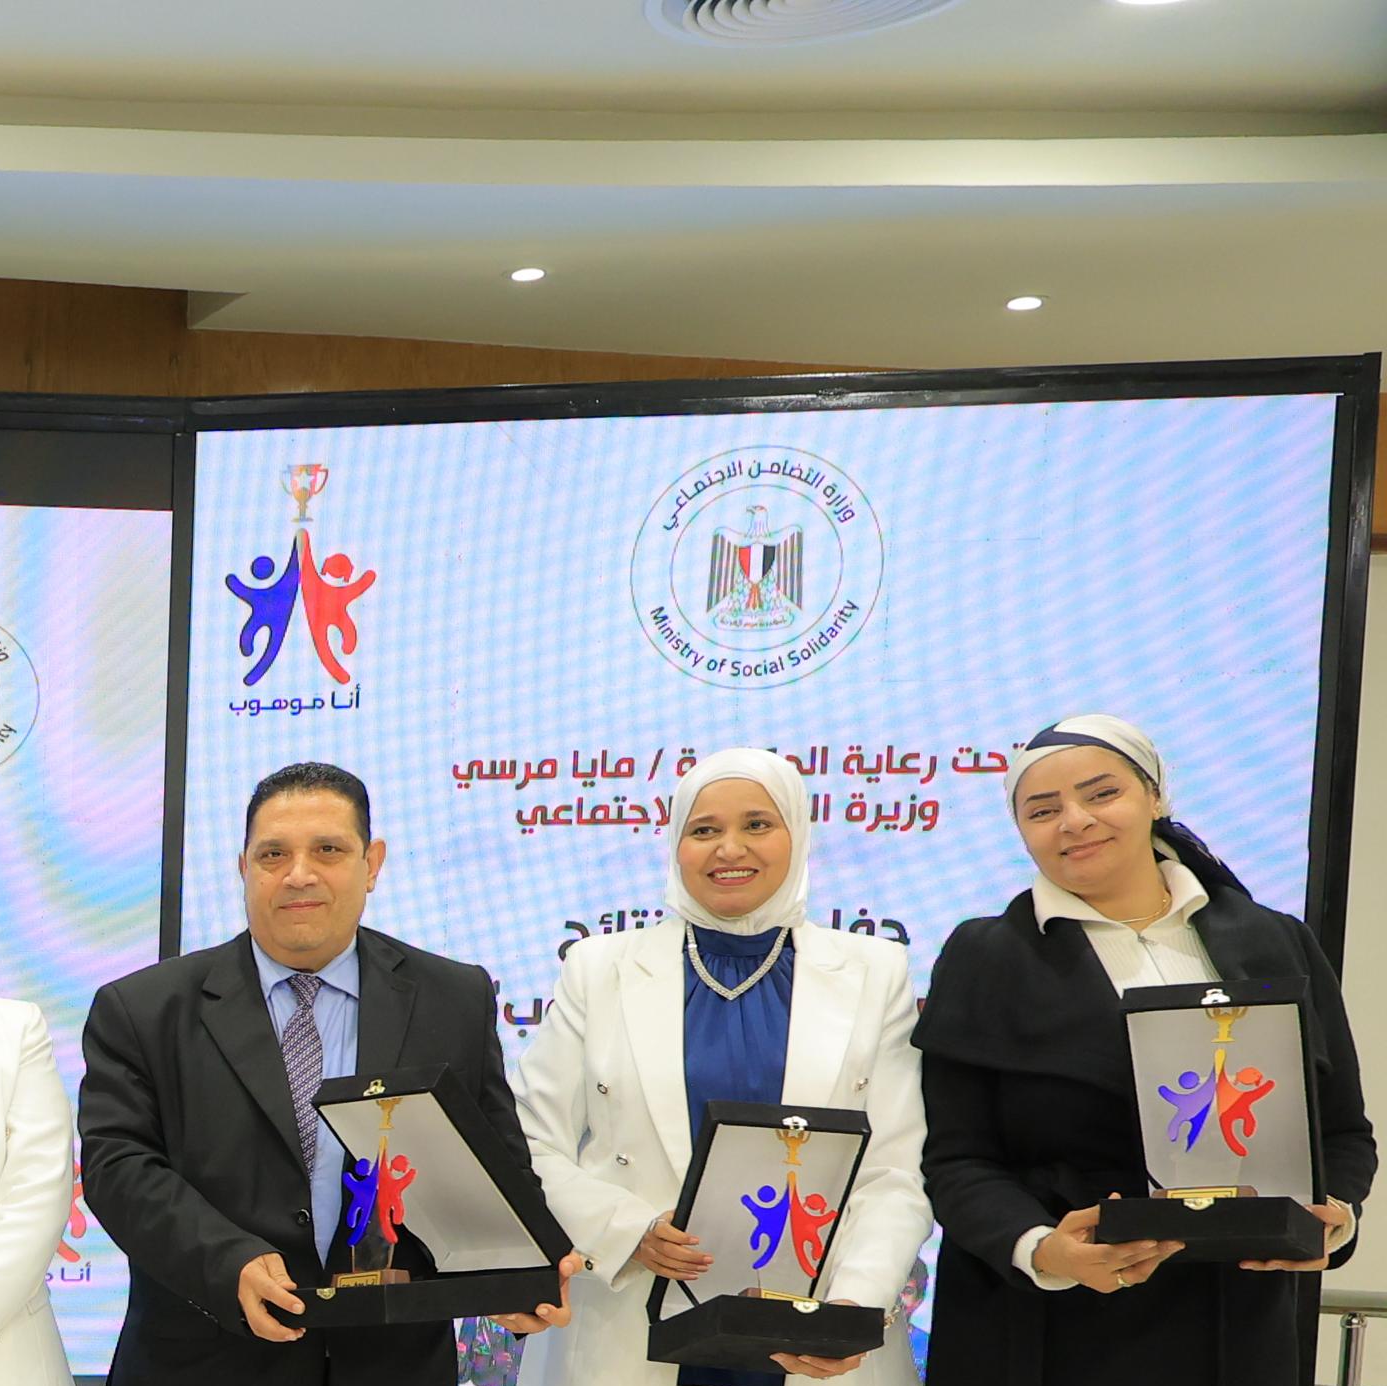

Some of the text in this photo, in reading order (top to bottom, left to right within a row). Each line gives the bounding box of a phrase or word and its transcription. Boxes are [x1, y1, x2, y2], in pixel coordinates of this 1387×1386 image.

[663, 459, 856, 531] وزارة التضامن الاجتماعي
[650, 599, 860, 677] Ministry of Social Solidarity
[229, 683, 362, 717] أنا موهوب
[452, 758, 558, 790] مرسي
[572, 749, 635, 787] مايا
[648, 747, 664, 781] /
[843, 745, 938, 784] رعاية
[952, 742, 1025, 773] حت
[516, 795, 673, 835] لإجتماعي
[845, 793, 940, 832] وزيرة
[61, 1261, 92, 1282] أنا
